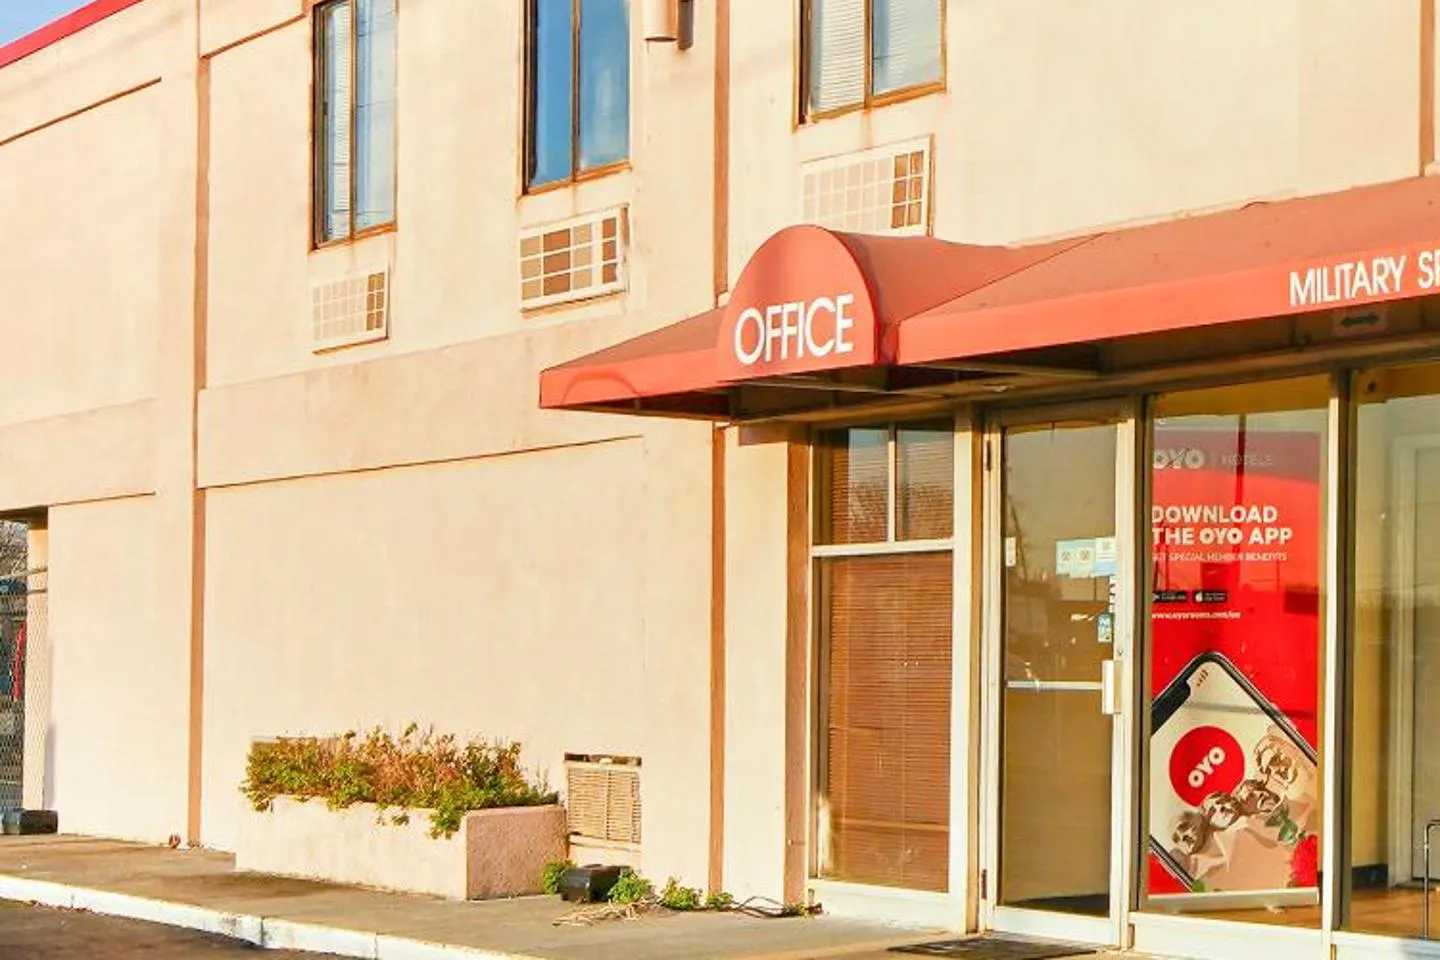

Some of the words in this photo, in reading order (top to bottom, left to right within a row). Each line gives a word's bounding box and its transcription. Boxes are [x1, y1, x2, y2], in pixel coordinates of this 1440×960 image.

[1289, 255, 1406, 307] MILITARY
[735, 293, 854, 365] OFFICE
[1153, 449, 1204, 469] OYO
[1152, 505, 1278, 523] DOWNLOAD
[1152, 527, 1194, 544] THE
[1199, 527, 1243, 544] OYO
[1248, 527, 1293, 544] APP
[1188, 746, 1226, 788] OYO
